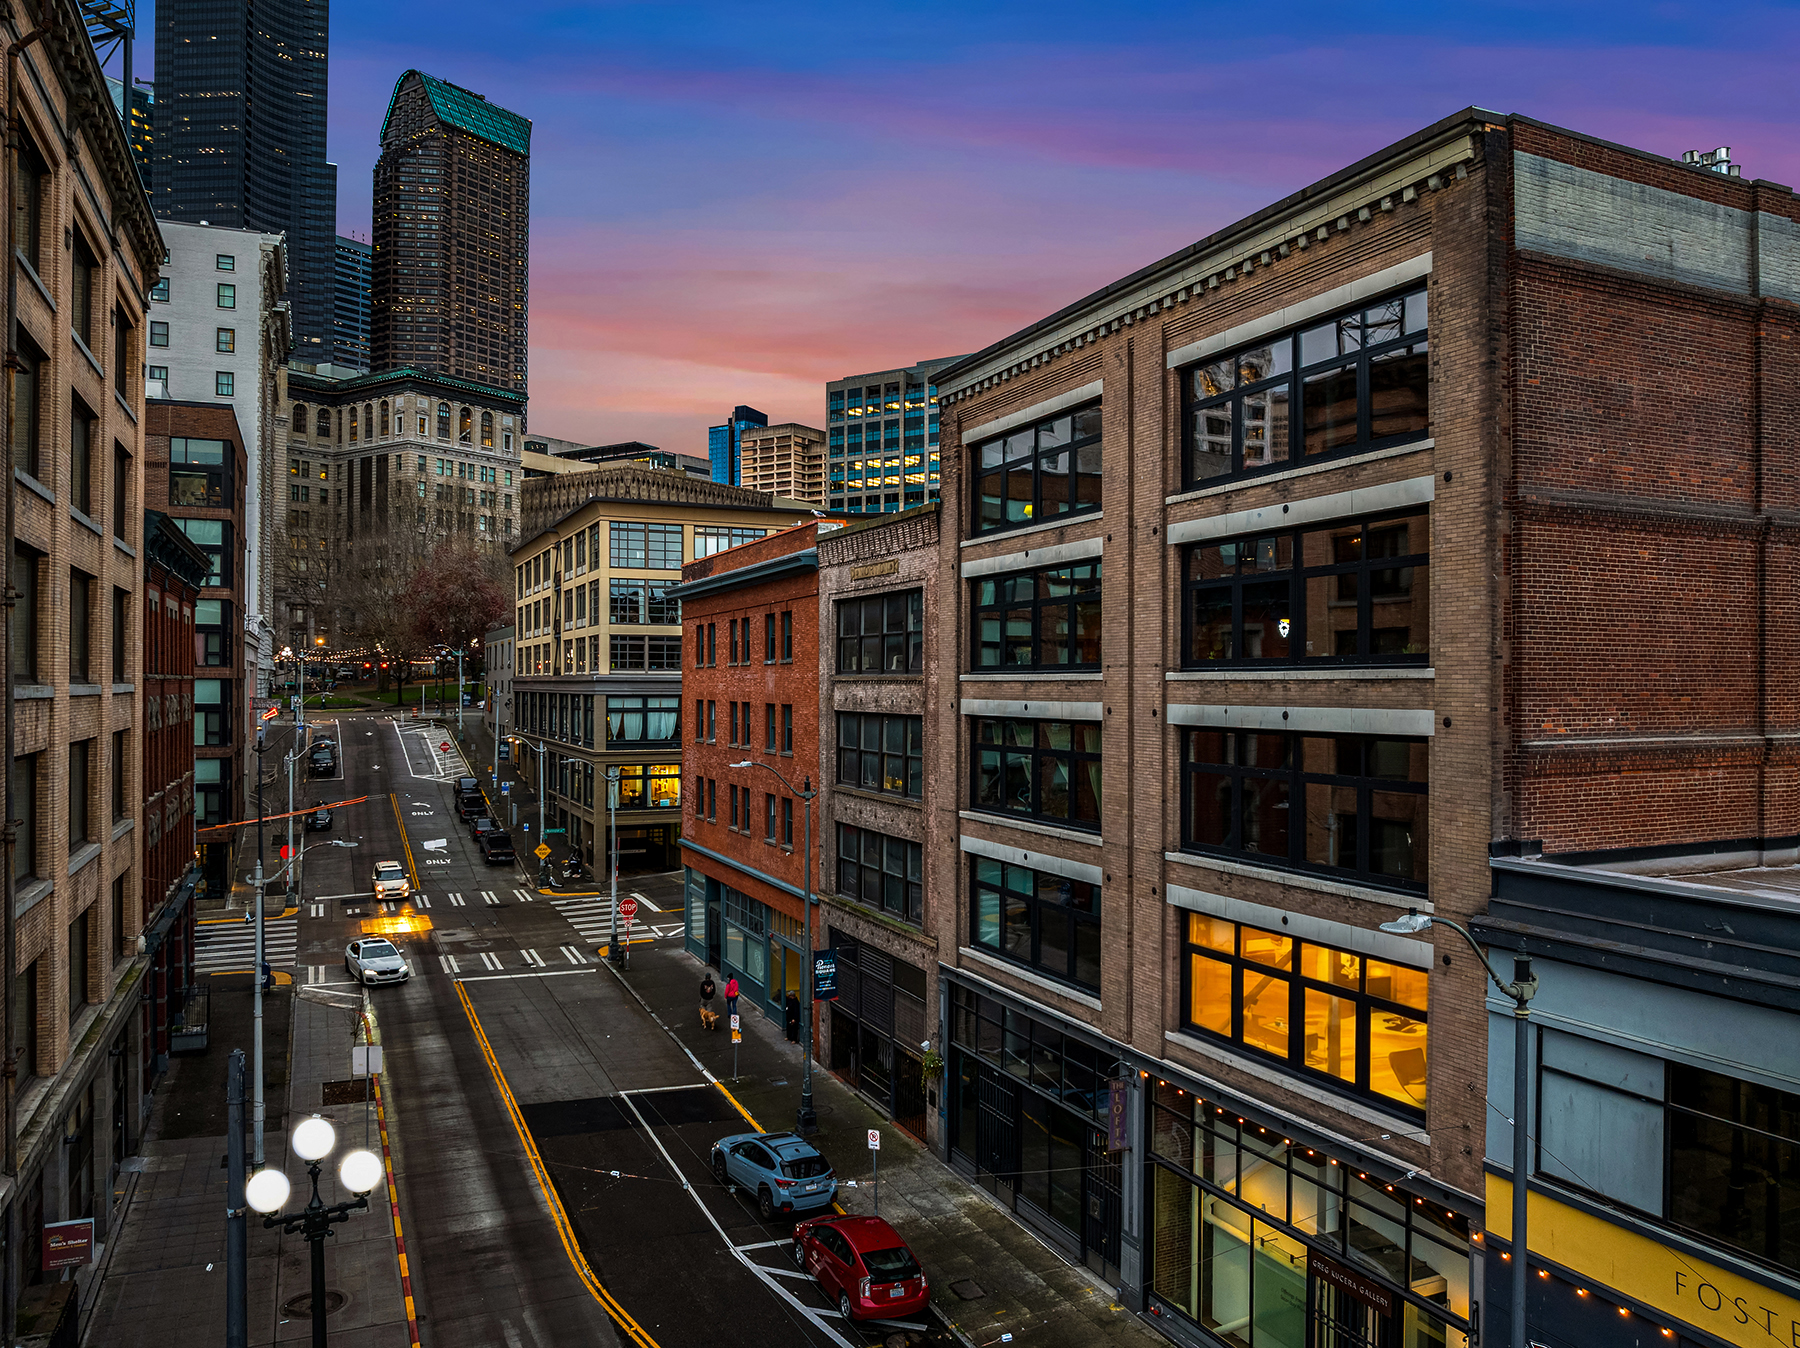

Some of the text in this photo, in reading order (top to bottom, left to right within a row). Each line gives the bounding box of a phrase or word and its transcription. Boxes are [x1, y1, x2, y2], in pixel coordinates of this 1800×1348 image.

[621, 903, 636, 912] STOP
[1111, 1082, 1124, 1090] THE
[1113, 1093, 1123, 1149] LOFTS
[1312, 1259, 1330, 1274] GREG
[1359, 1286, 1389, 1308] GALLERY
